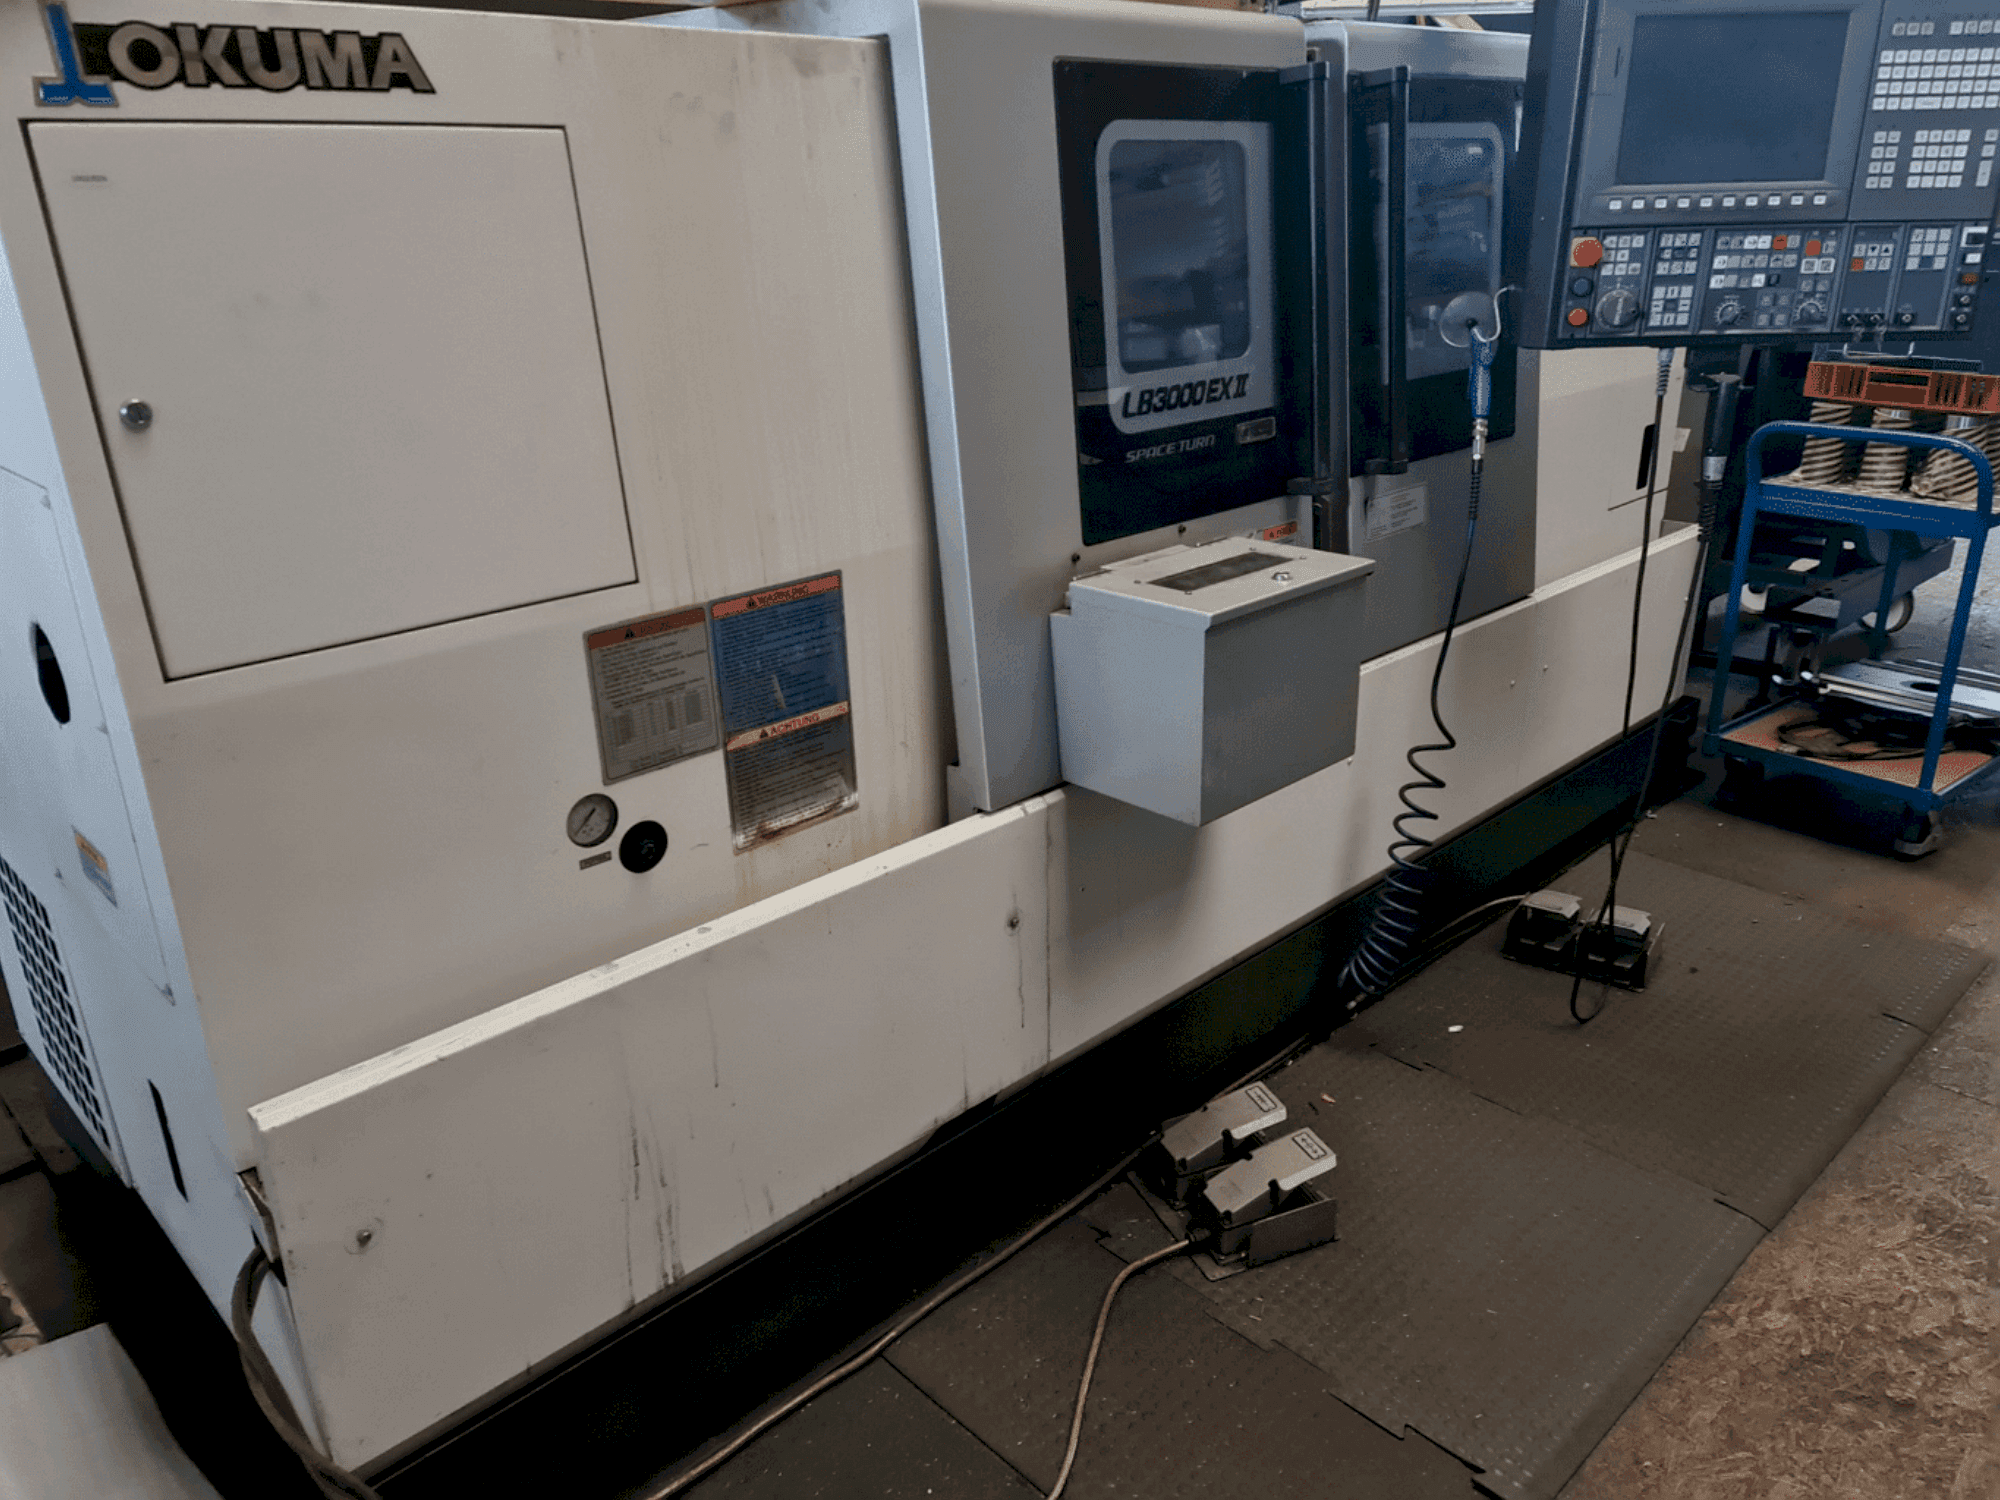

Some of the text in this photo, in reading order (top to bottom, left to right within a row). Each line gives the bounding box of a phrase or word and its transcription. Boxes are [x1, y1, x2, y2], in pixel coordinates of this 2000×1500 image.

[108, 20, 436, 93] OKUMA
[1125, 434, 1216, 463] SPACE TURN
